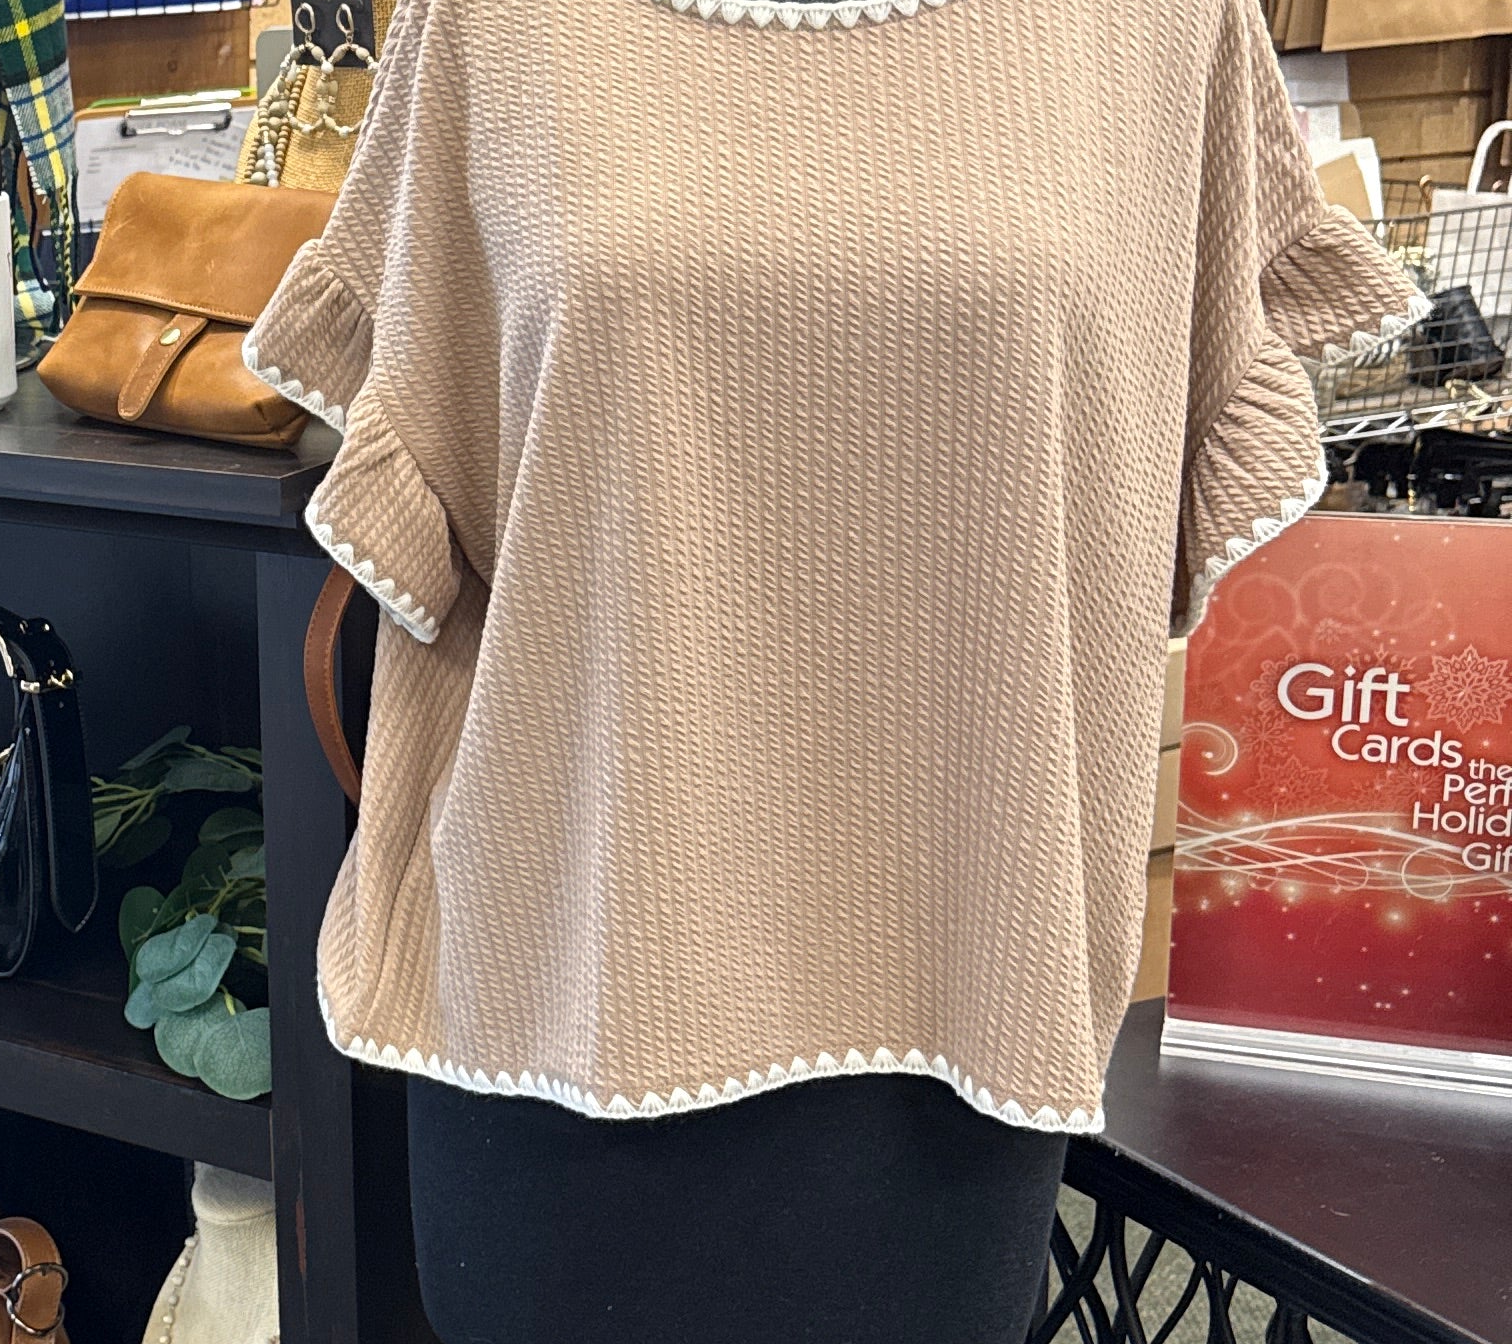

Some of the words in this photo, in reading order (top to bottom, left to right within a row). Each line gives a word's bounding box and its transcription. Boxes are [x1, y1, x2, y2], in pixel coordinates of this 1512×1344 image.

[1277, 662, 1411, 727] Gift
[1331, 723, 1463, 769] Cards
[1468, 758, 1512, 781] the
